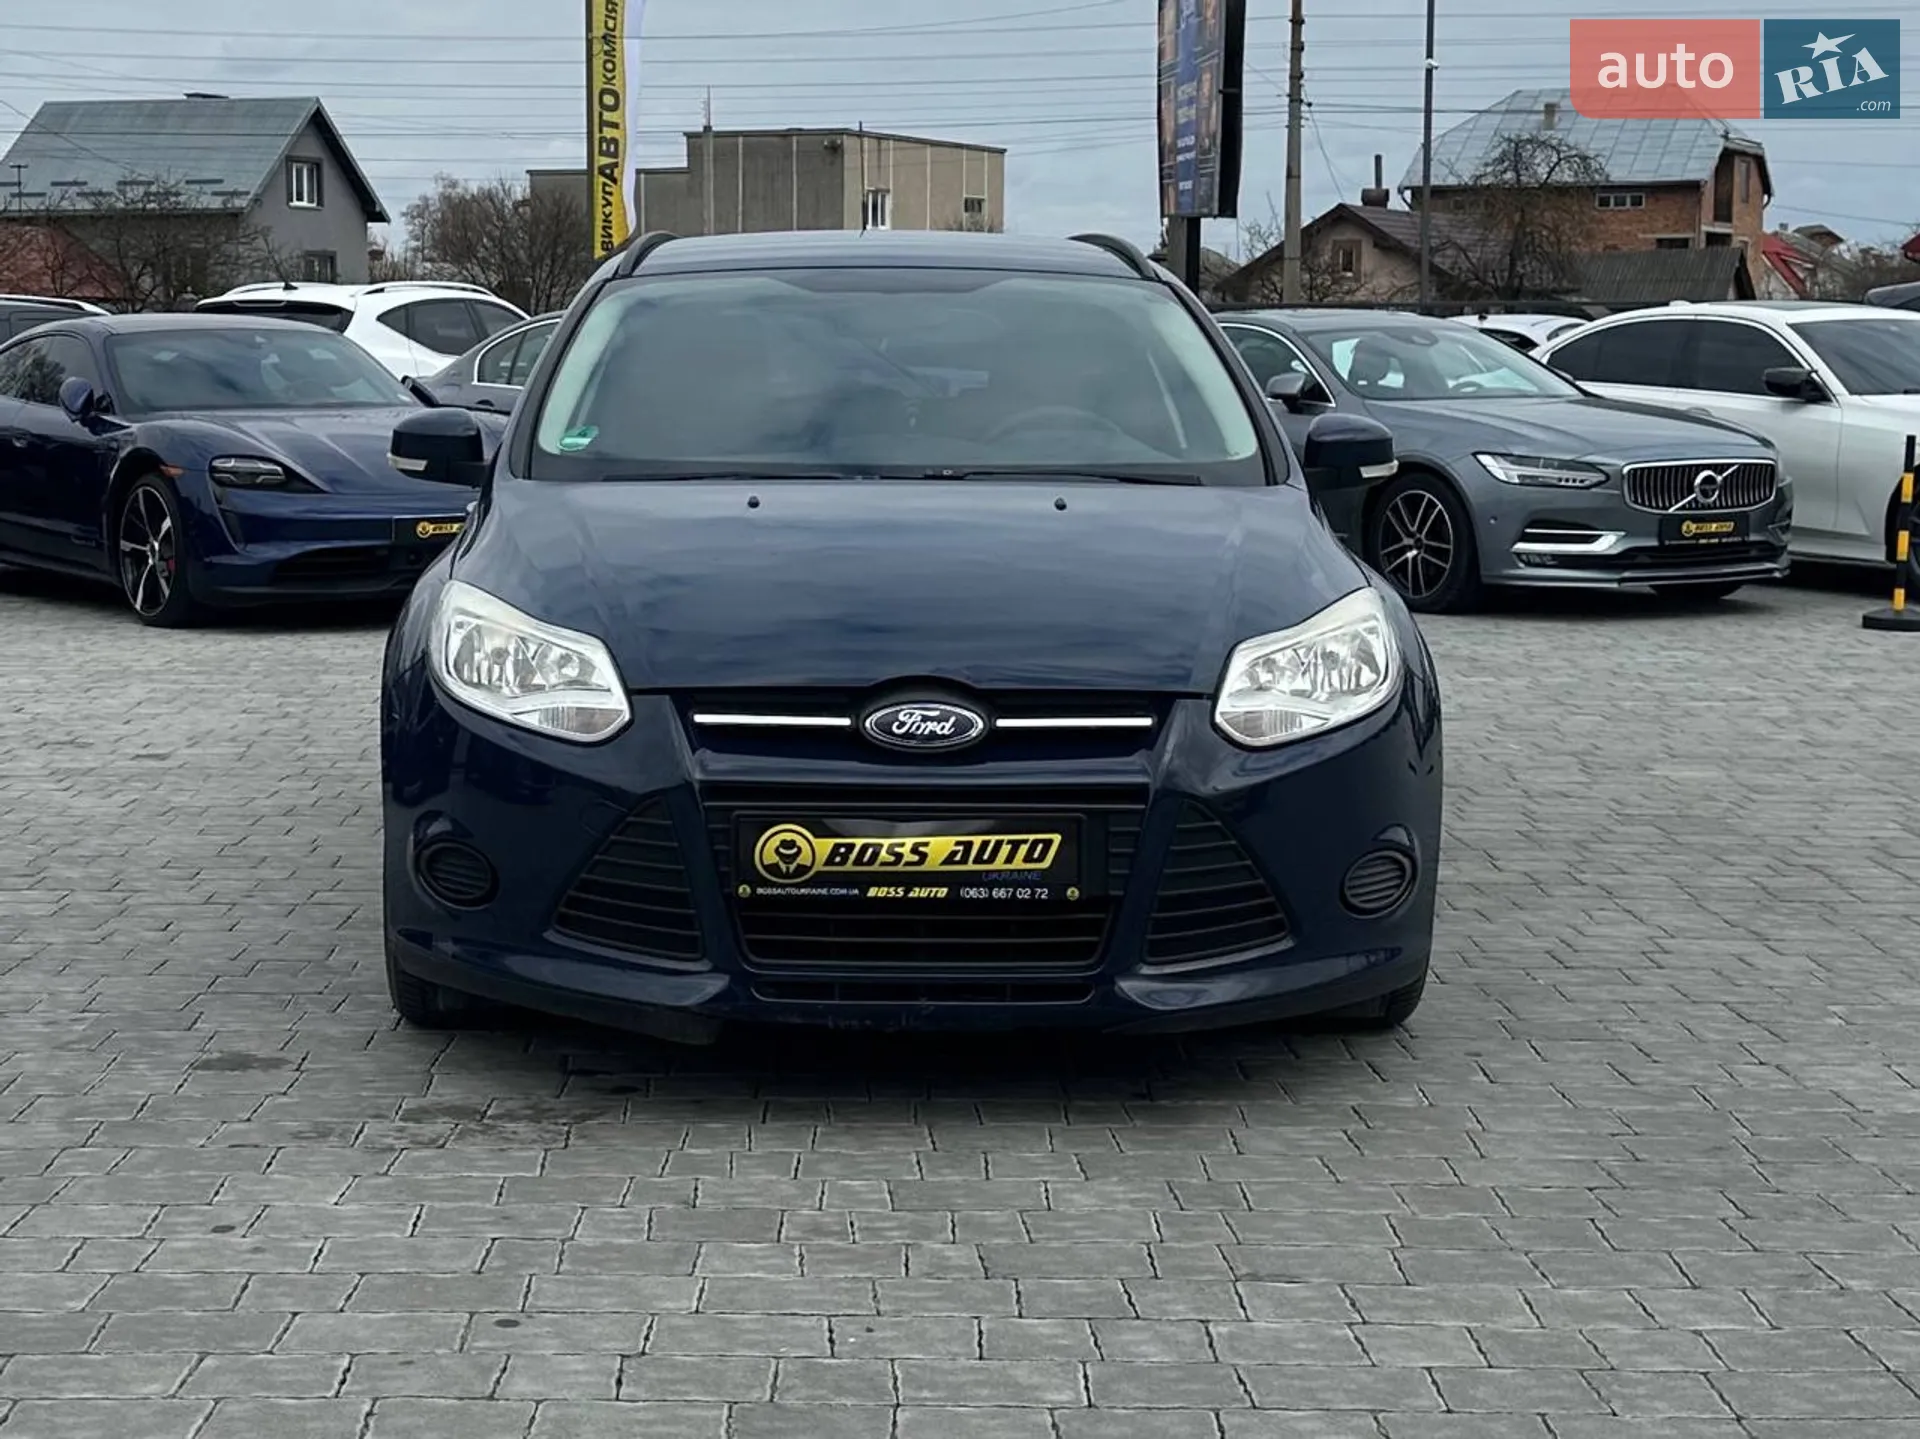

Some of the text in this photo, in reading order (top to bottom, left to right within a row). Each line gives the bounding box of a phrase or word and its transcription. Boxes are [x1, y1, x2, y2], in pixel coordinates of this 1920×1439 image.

[598, 87, 621, 186] АВТО
[600, 184, 615, 253] ВИКУП
[892, 709, 956, 735] Ford
[824, 838, 1053, 867] BOSS AUTO
[982, 871, 1043, 881] UKRAINE
[867, 887, 949, 898] BOSS AUTO
[960, 887, 1049, 900] (063) 667 02 72
